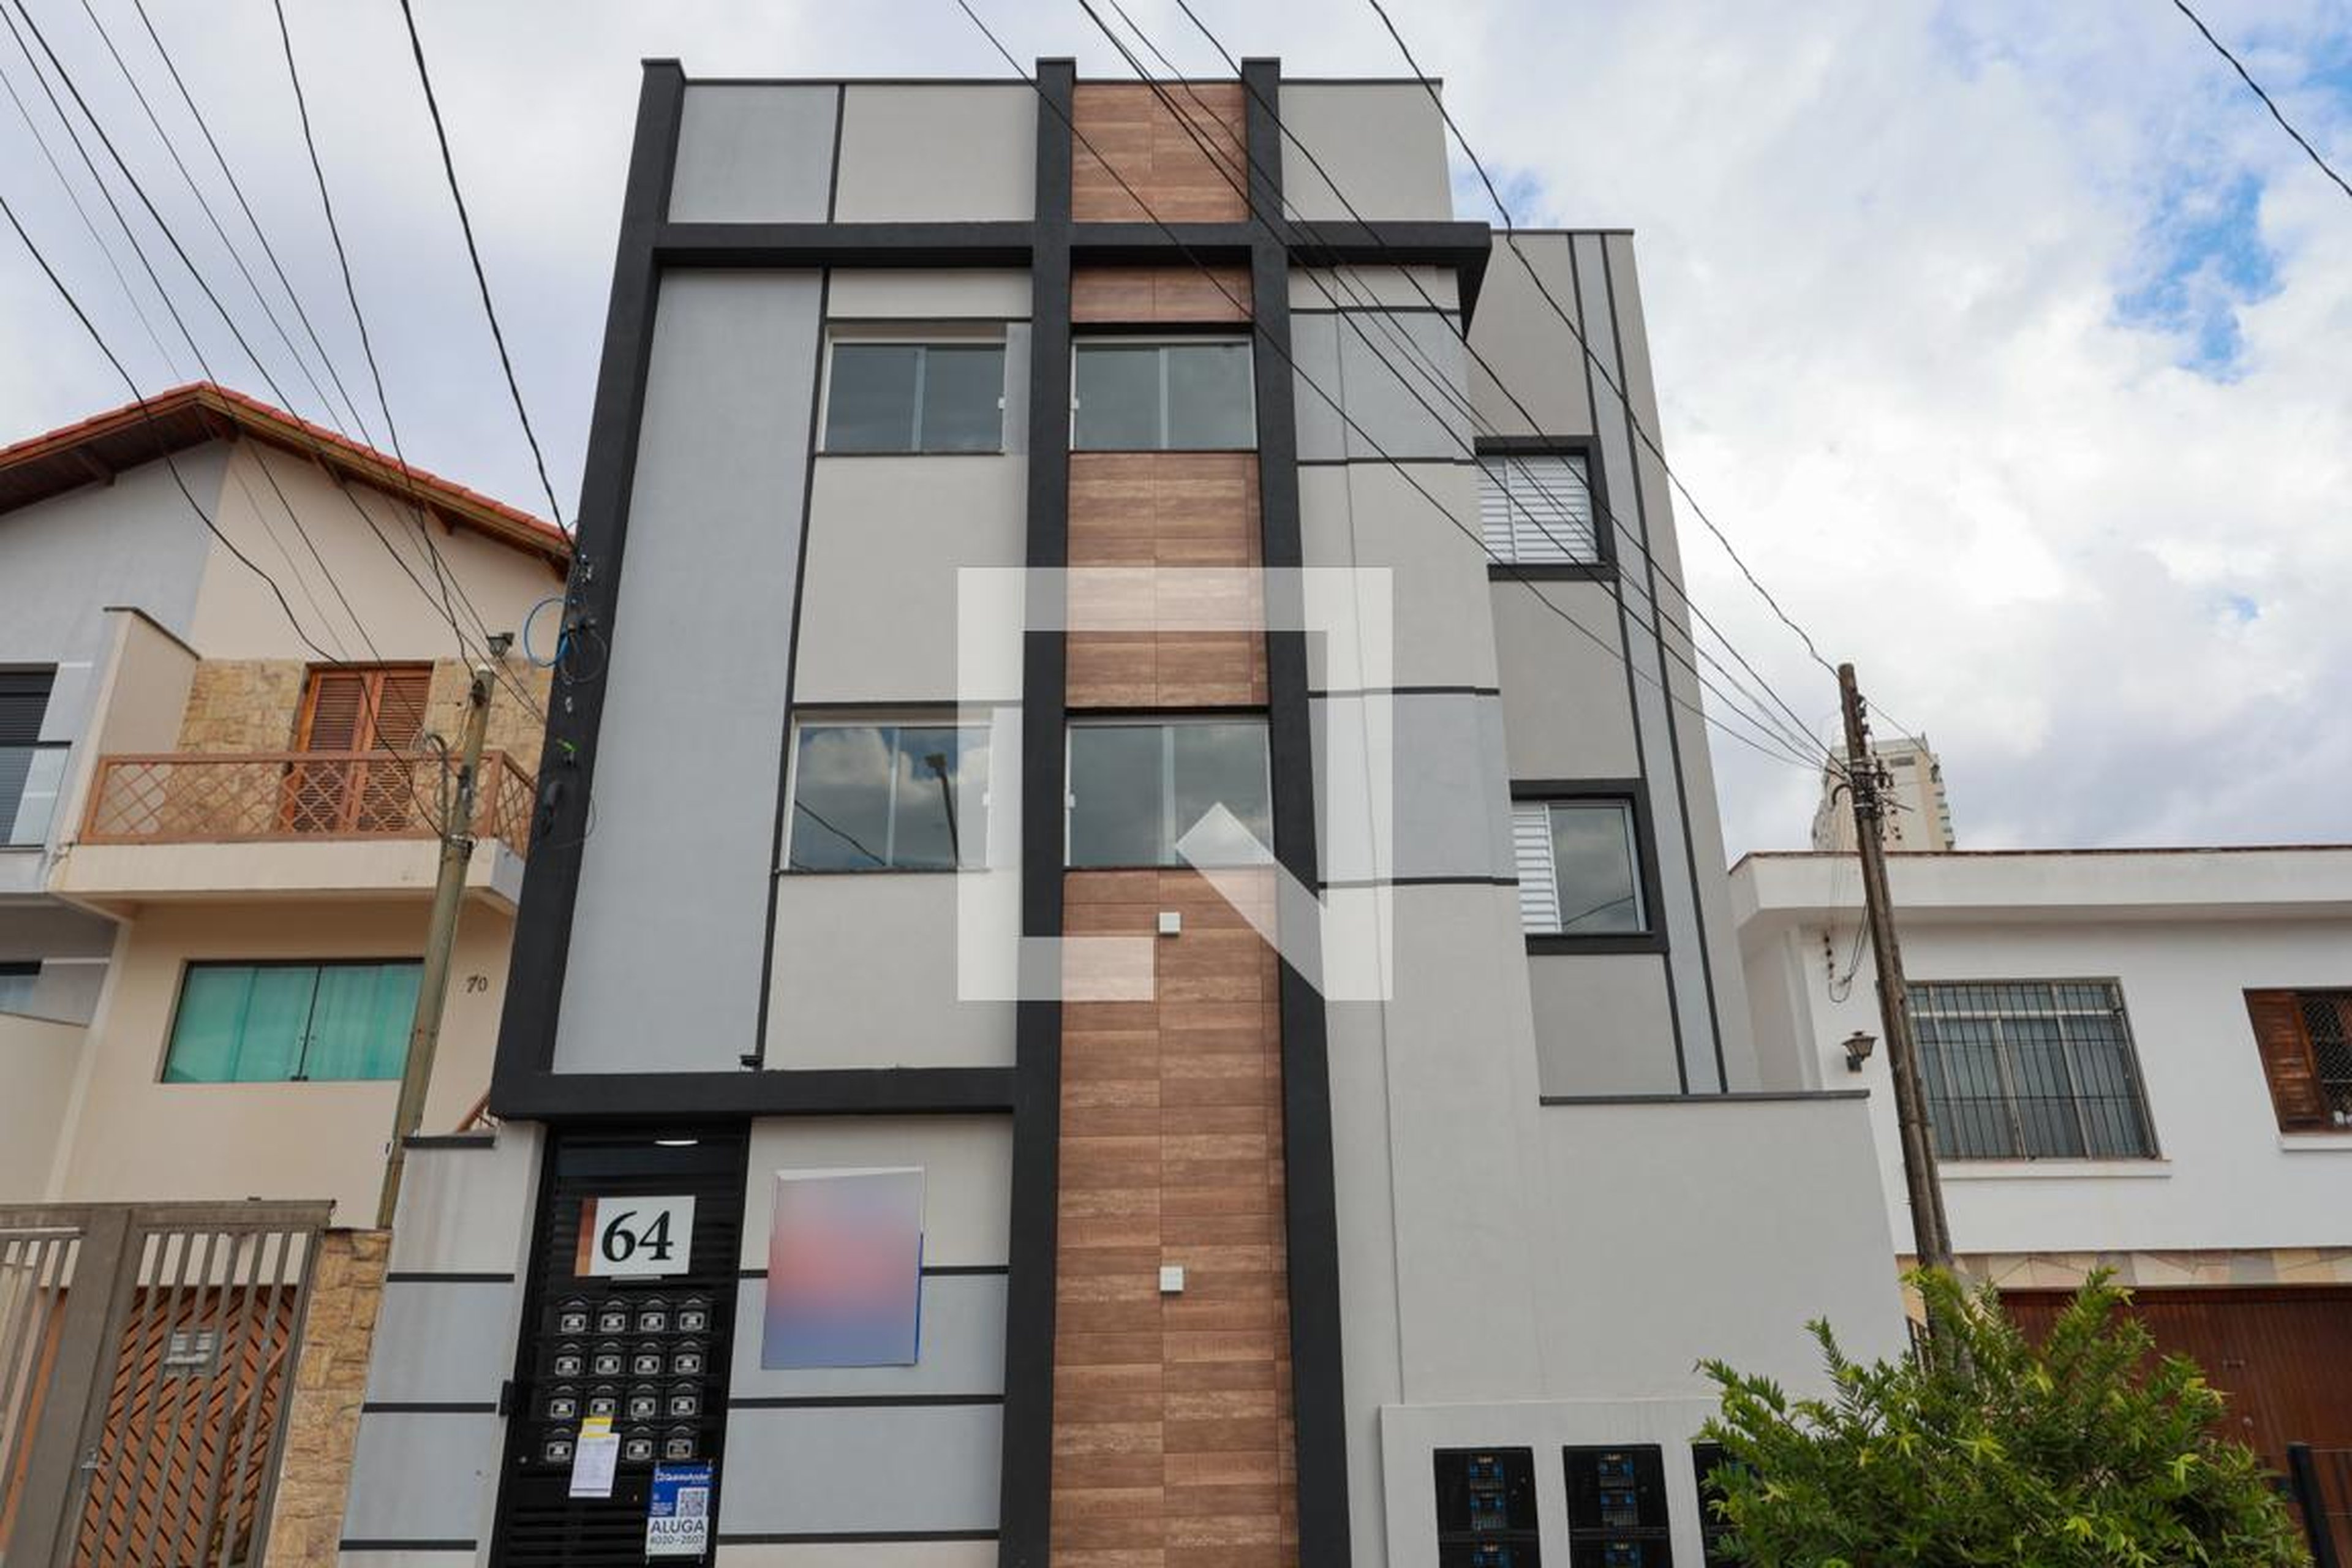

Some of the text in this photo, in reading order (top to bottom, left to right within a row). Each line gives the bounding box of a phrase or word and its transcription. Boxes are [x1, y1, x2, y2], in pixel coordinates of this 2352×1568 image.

[467, 974, 488, 993] 70
[602, 1210, 674, 1262] 64
[650, 1519, 705, 1534] ALUGA
